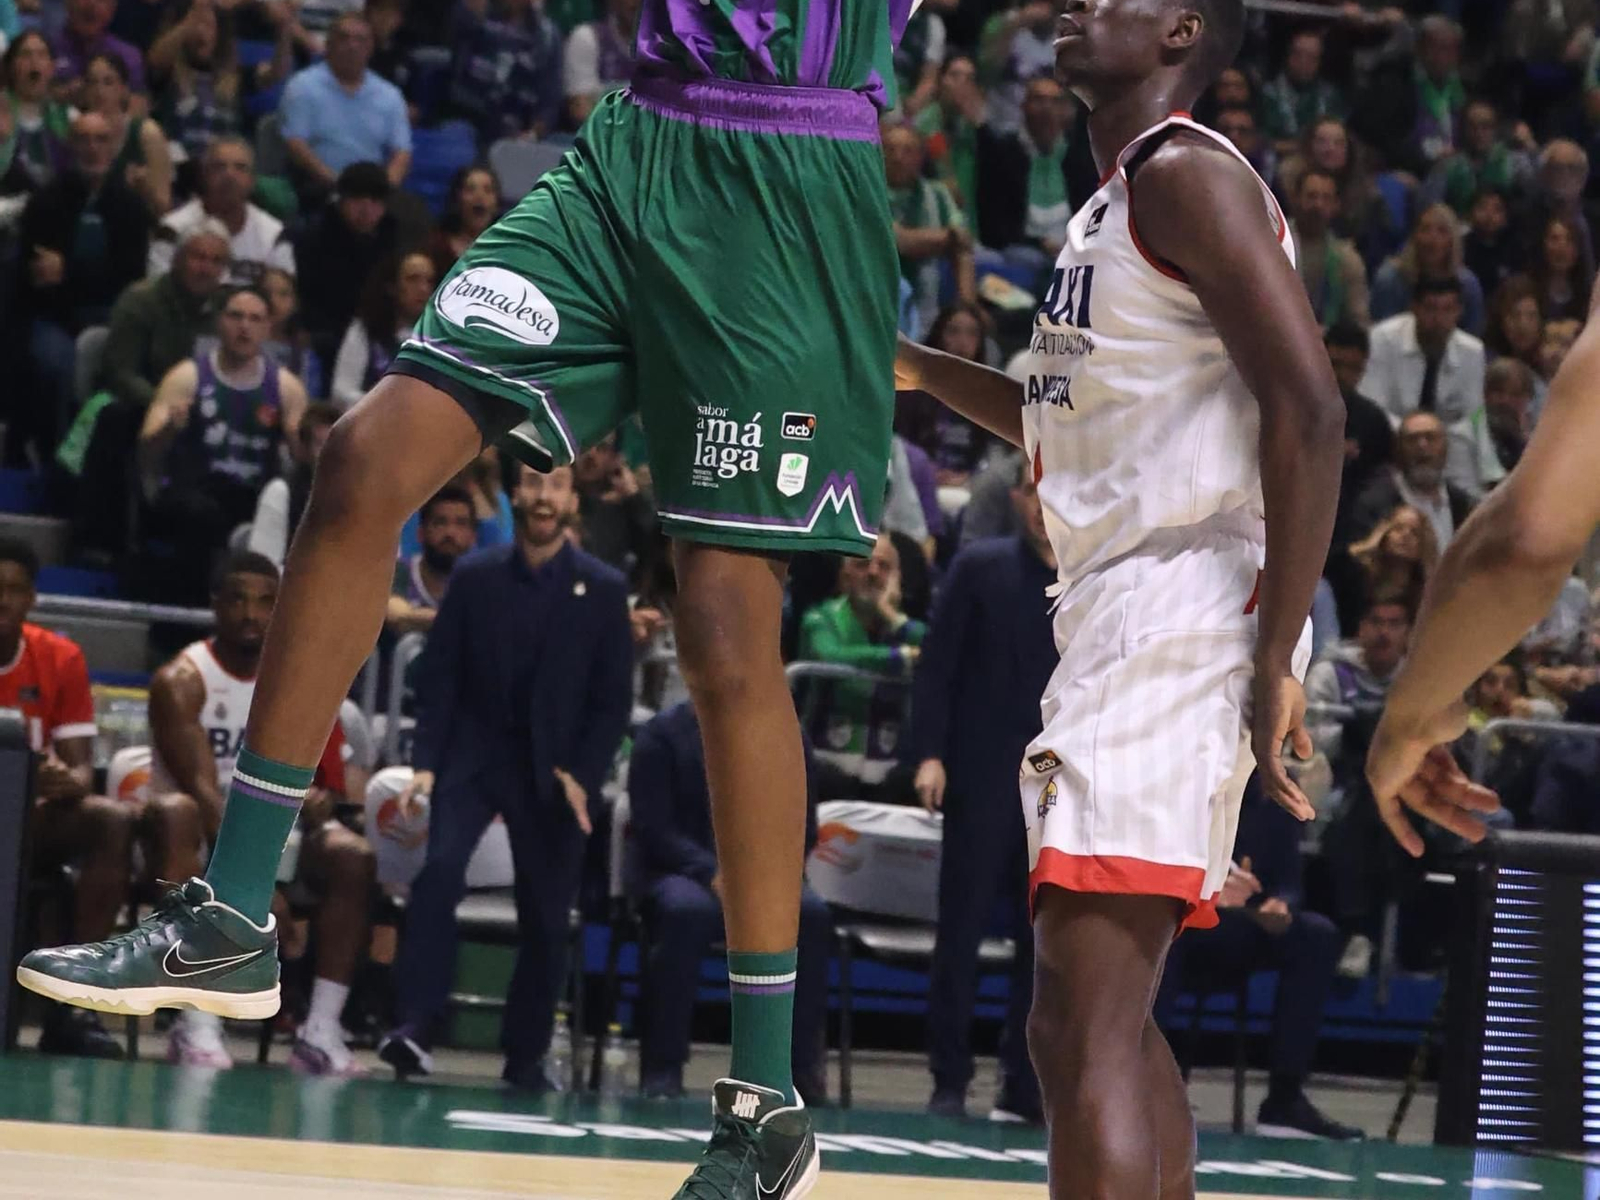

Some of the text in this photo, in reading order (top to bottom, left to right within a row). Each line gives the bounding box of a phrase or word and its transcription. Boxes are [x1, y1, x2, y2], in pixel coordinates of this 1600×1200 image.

[1034, 265, 1095, 329] AXI
[697, 402, 729, 417] sabor
[705, 411, 764, 448] má
[785, 423, 811, 437] acb
[693, 433, 761, 479] laga
[1035, 758, 1057, 772] acb
